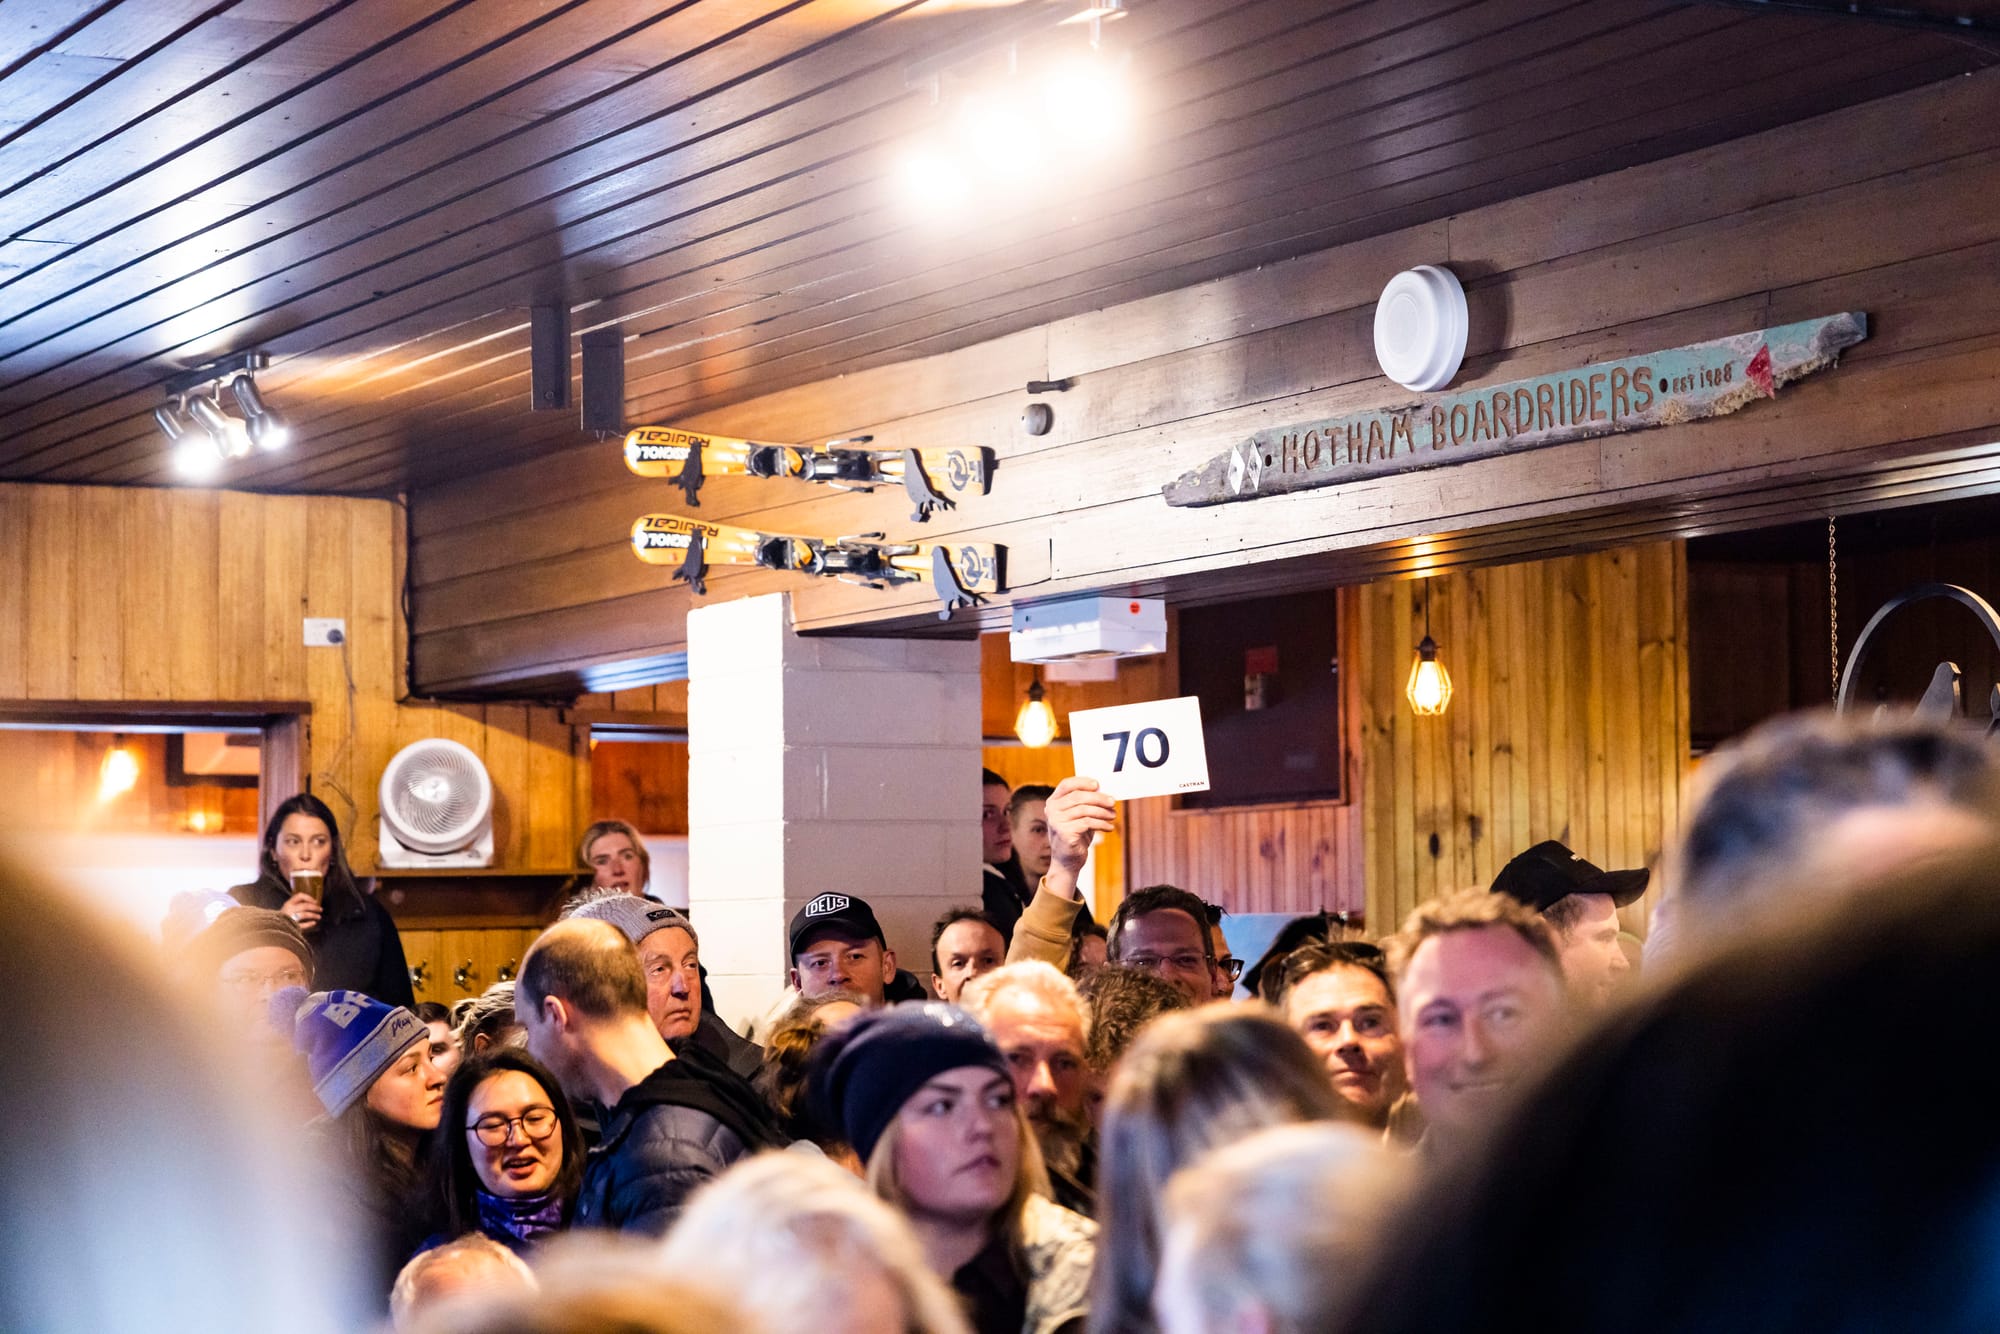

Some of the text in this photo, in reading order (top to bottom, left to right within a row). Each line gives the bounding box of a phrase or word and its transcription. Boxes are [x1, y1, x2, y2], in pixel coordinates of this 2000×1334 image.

[1281, 413, 1415, 474] HOTHAM
[1431, 366, 1654, 450] BOARDRIDERS
[1700, 362, 1732, 388] 1988
[1102, 726, 1170, 773] 70
[810, 896, 845, 914] DEUS
